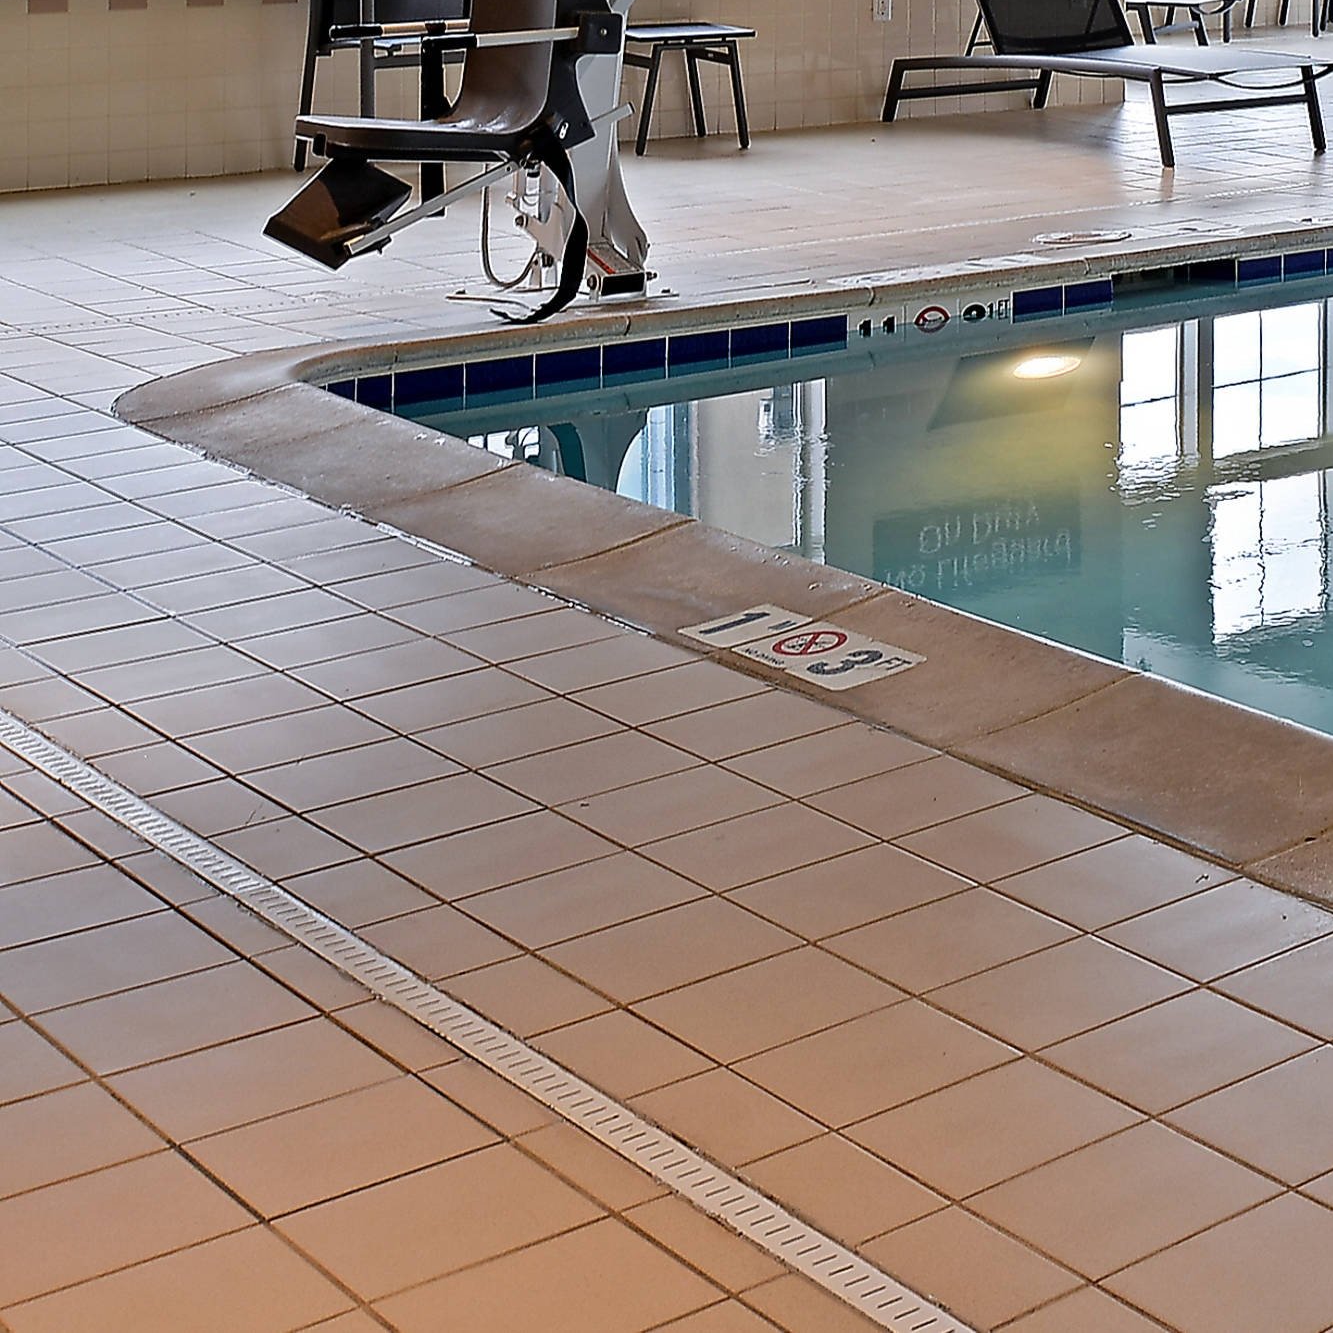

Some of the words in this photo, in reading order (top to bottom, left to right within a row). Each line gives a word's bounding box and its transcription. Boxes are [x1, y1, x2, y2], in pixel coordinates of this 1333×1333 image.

[700, 611, 771, 635] 1
[806, 649, 884, 675] 3
[874, 656, 913, 670] FT
